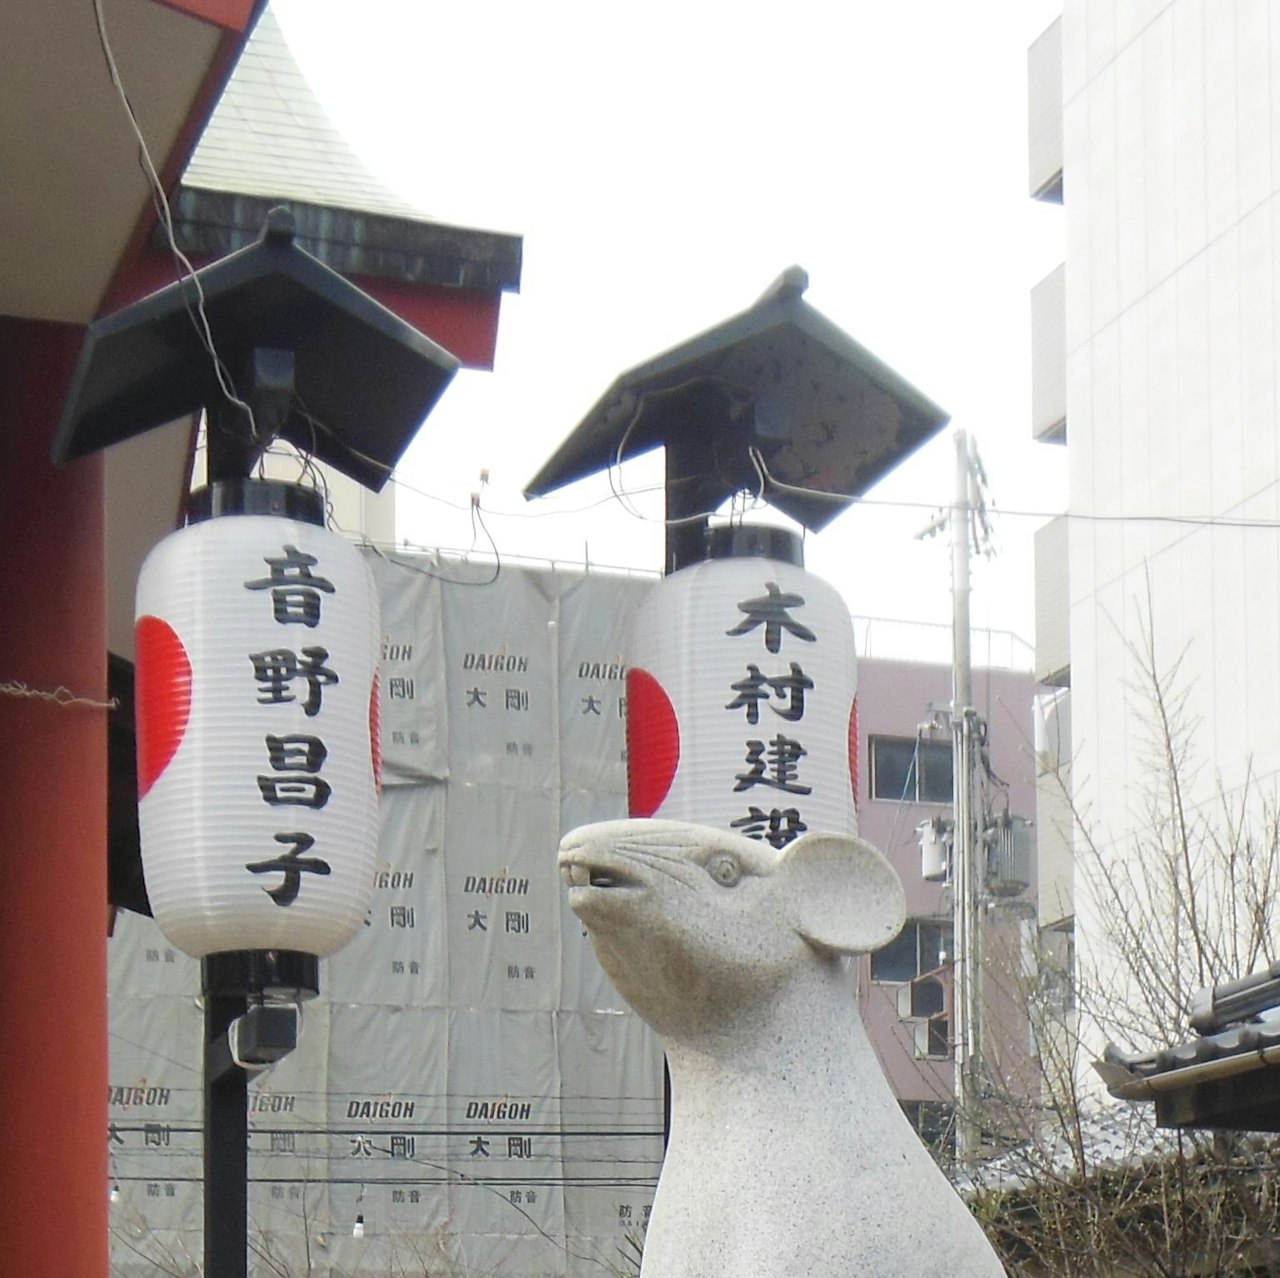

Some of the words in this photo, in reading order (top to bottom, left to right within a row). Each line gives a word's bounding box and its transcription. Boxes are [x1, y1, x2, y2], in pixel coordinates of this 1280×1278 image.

[464, 653, 528, 671] DAIGOH
[467, 687, 528, 711] 大剛
[244, 545, 339, 906] 音野昌子
[464, 876, 529, 895] DAIGOH
[467, 910, 529, 933] 大剛
[347, 1101, 415, 1118] DAIGOH
[466, 1102, 531, 1119] DAIGOH
[469, 1136, 531, 1158] 大剛
